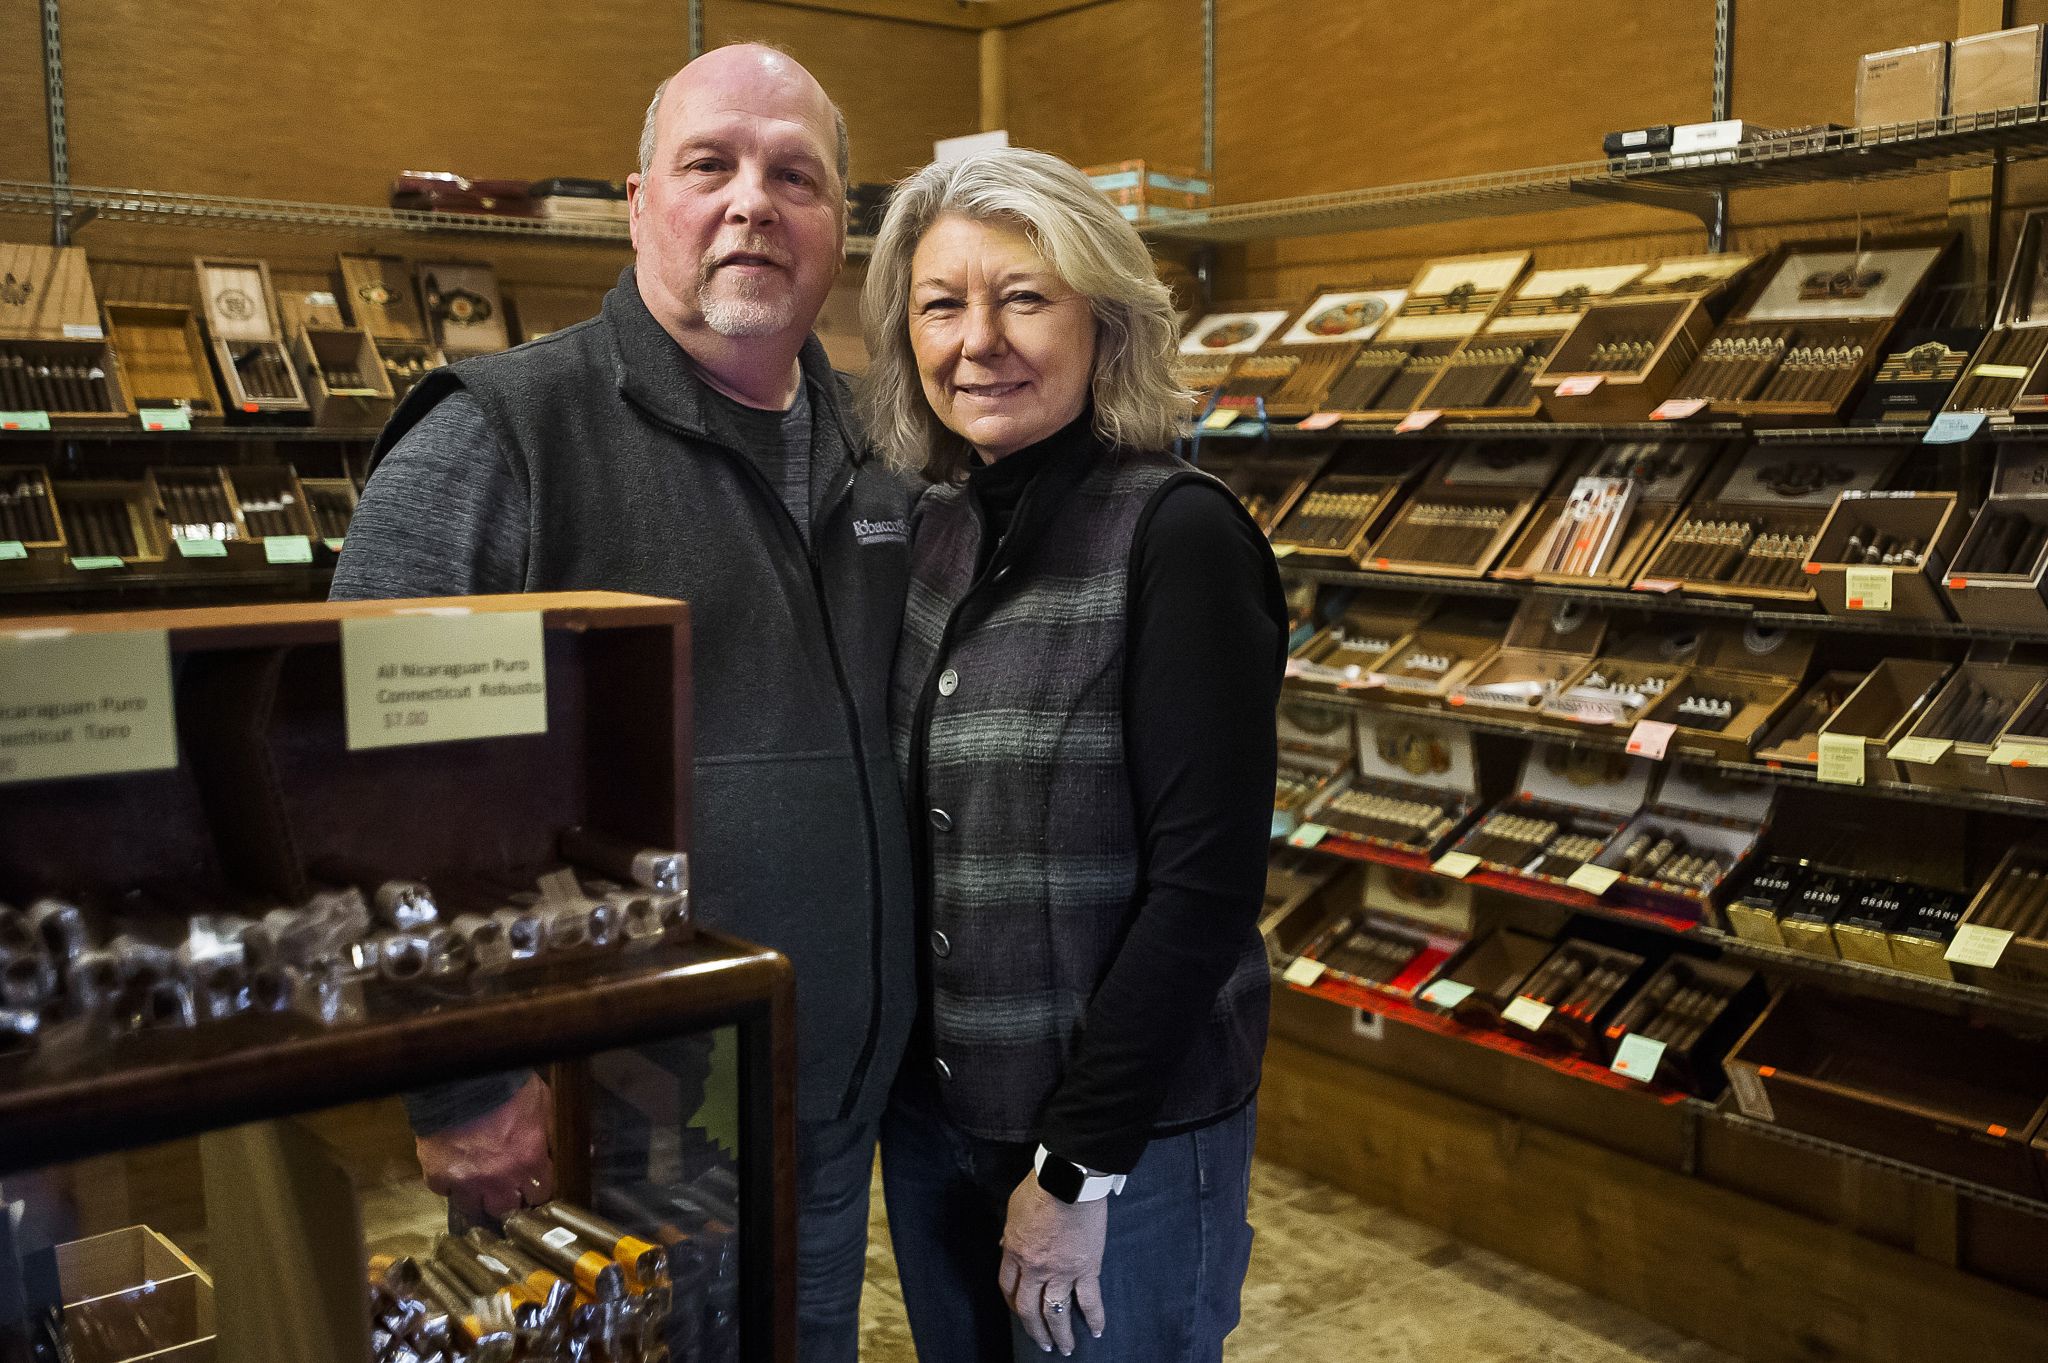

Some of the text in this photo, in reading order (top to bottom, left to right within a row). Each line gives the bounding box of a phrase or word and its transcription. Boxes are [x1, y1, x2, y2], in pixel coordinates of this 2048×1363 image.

[377, 659, 530, 679] All Nicaraguan Puro
[376, 686, 472, 704] Connecticut
[100, 696, 148, 712] Puro
[85, 723, 132, 739] Toro
